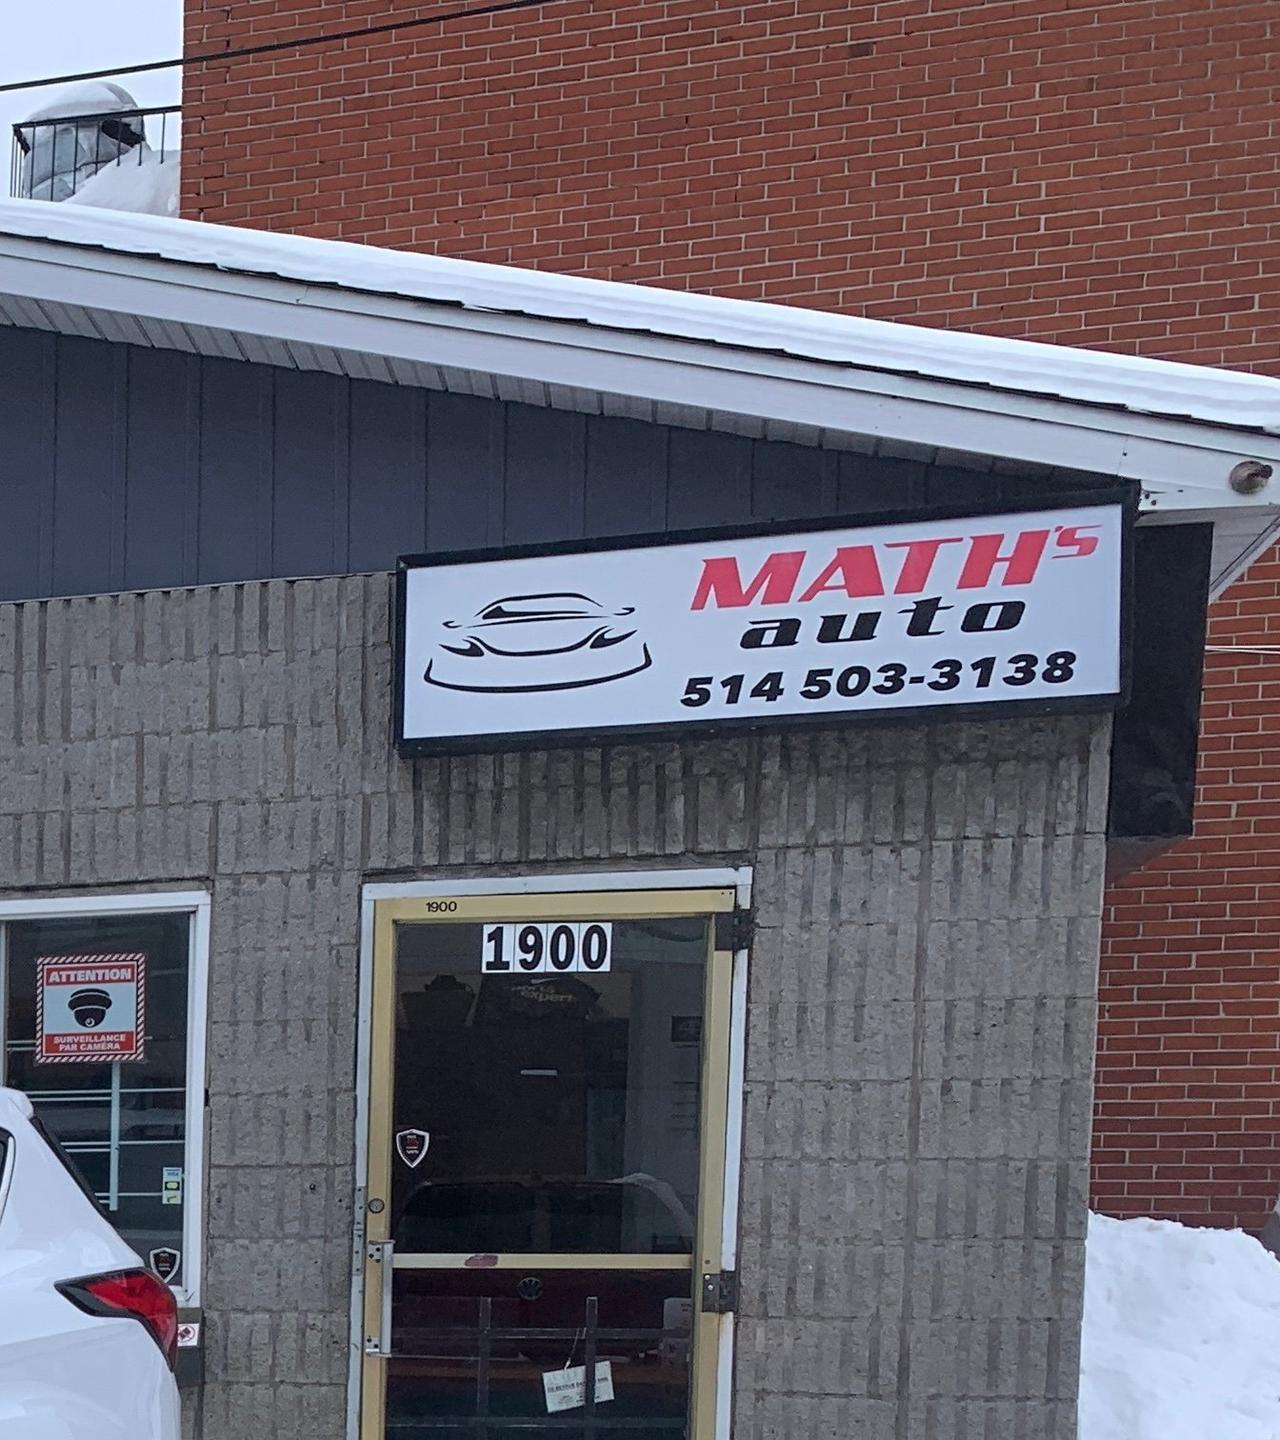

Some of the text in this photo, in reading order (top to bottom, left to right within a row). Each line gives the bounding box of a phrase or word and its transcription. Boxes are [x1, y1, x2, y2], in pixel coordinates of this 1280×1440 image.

[739, 596, 1027, 649] auto
[680, 651, 1077, 707] 514 503-3138
[425, 901, 457, 912] 1900
[485, 924, 608, 971] 1900
[48, 967, 132, 983] ATTENTION
[53, 1033, 126, 1044] SURVEILLANCE
[59, 1043, 77, 1052] PAR
